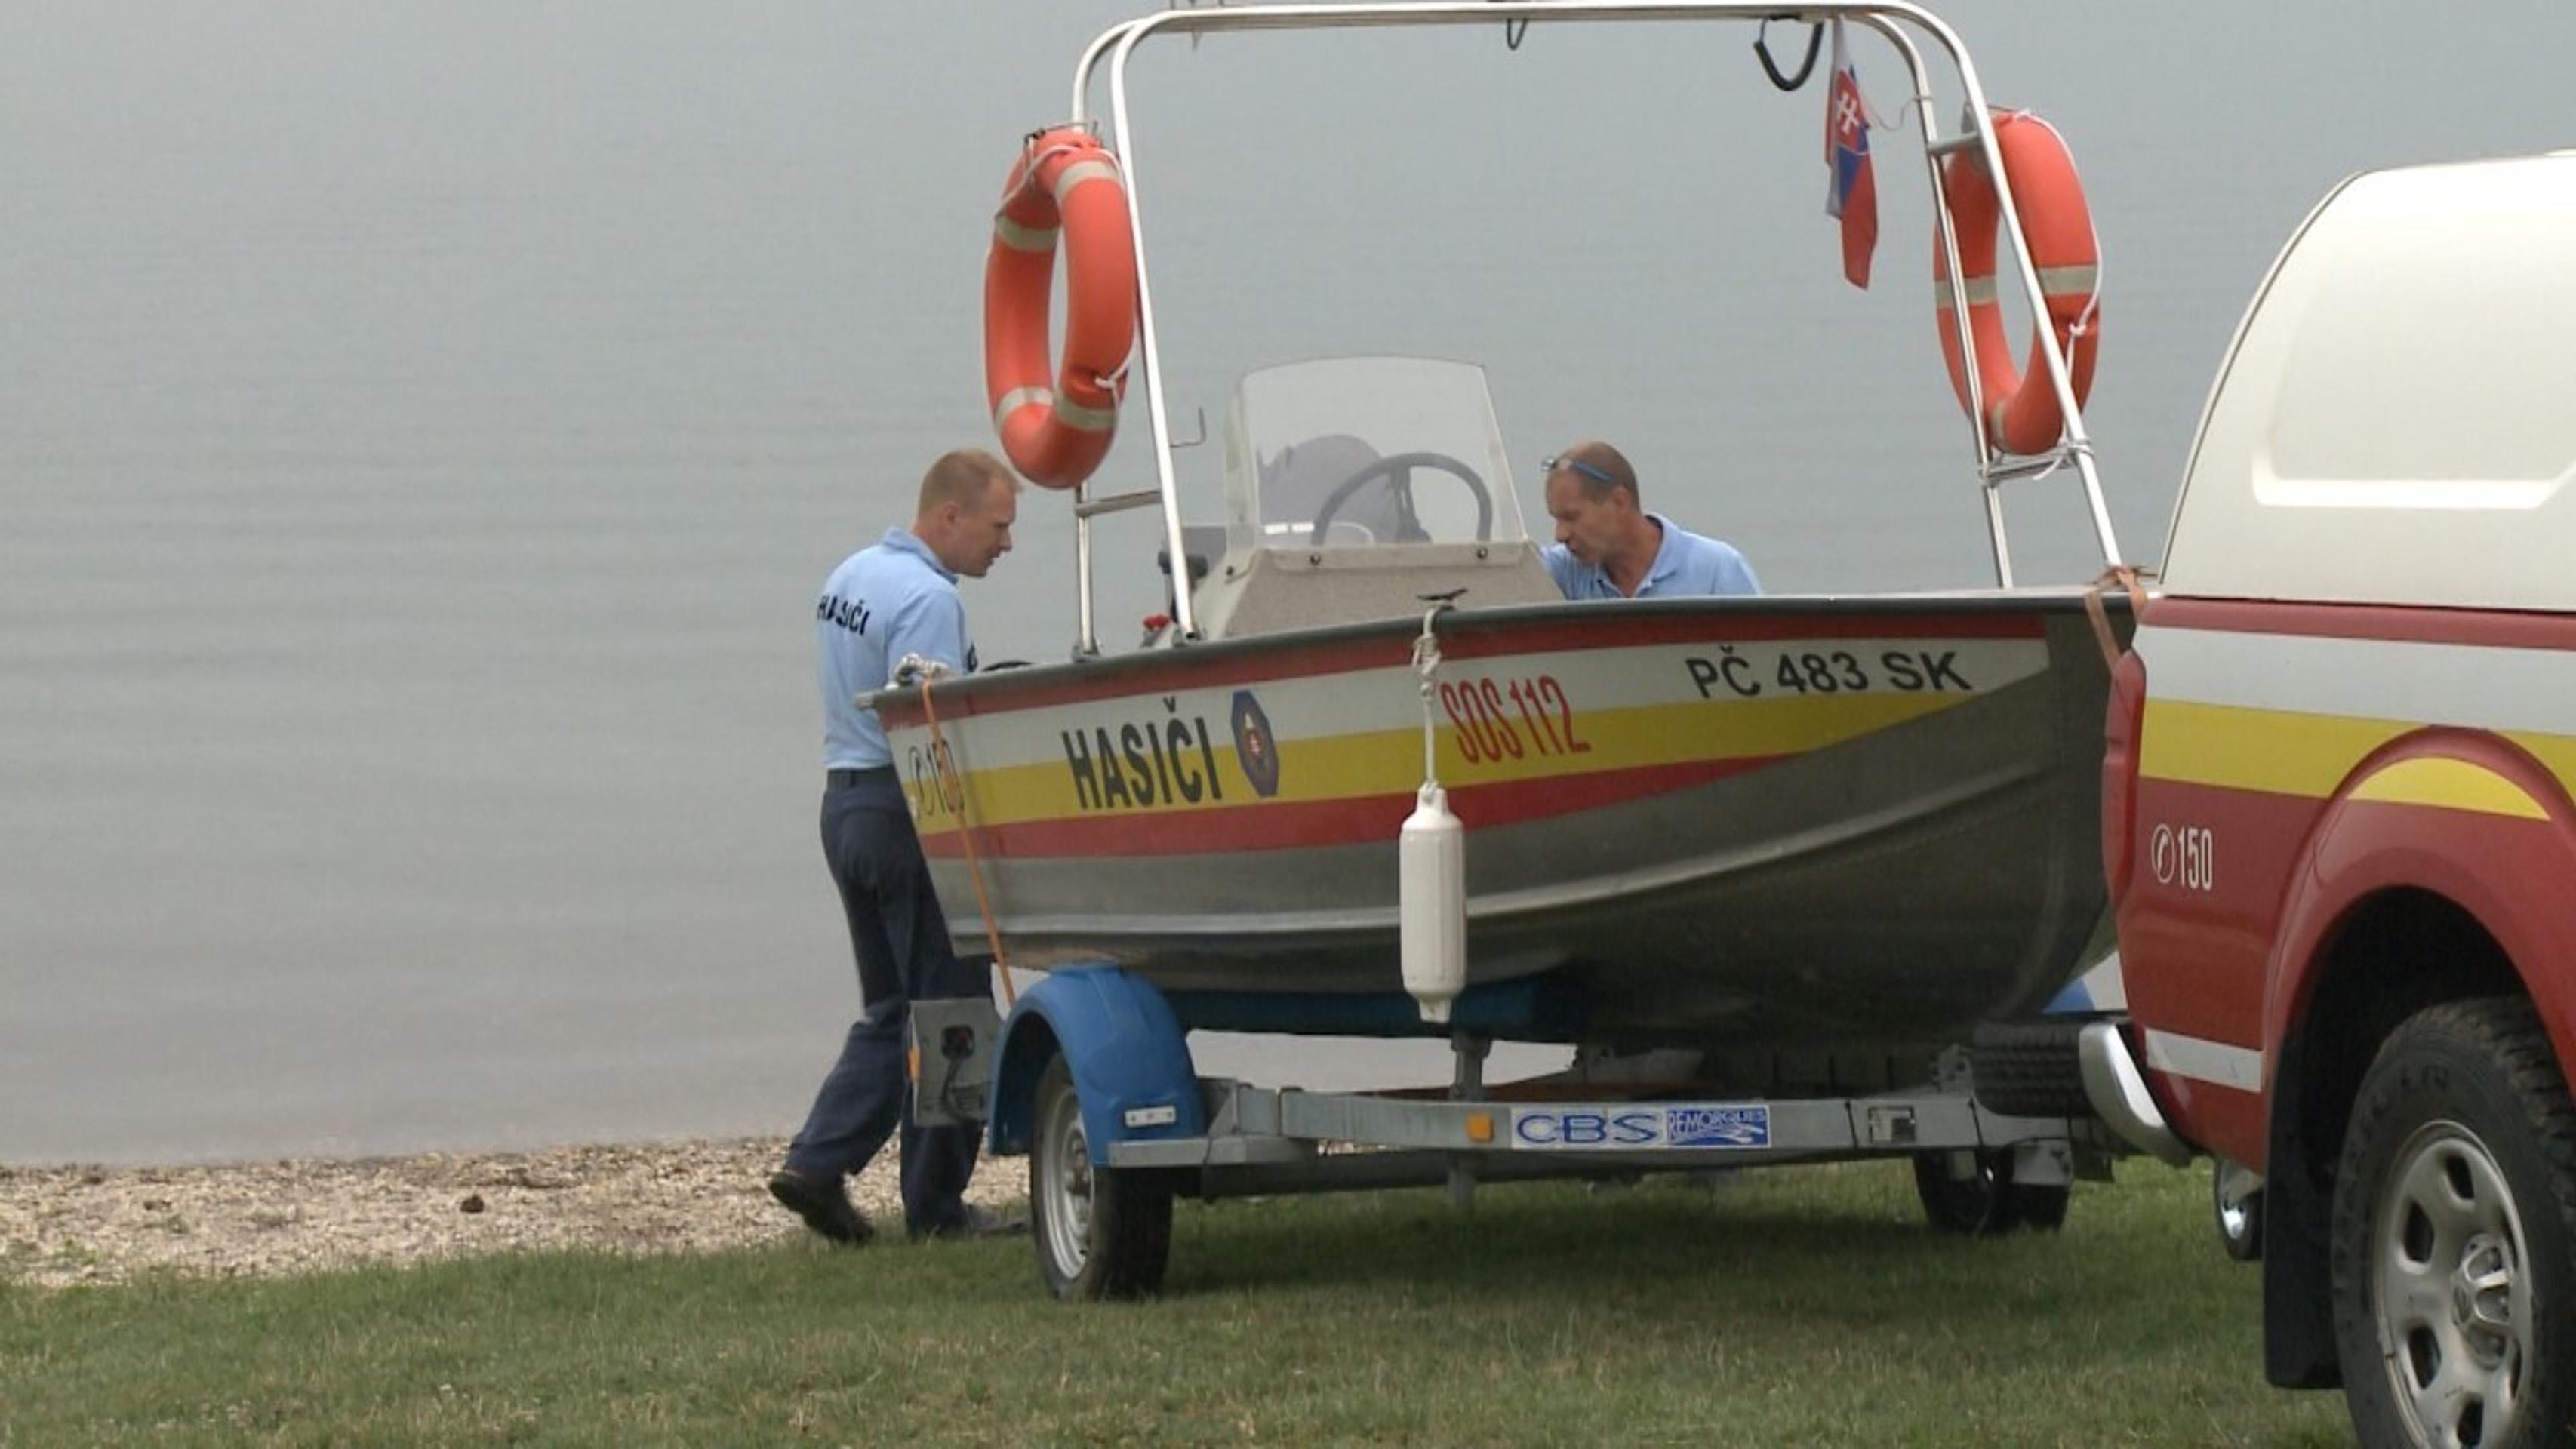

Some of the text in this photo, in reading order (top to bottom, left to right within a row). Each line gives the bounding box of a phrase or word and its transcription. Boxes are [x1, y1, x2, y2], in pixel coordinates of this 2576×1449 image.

[1685, 646, 1973, 699] PČ 483 SK
[1440, 676, 1592, 764] SOS 112
[1062, 697, 1223, 810] HASIČI
[2178, 826, 2214, 891] 150
[1517, 1114, 1658, 1144] CBS
